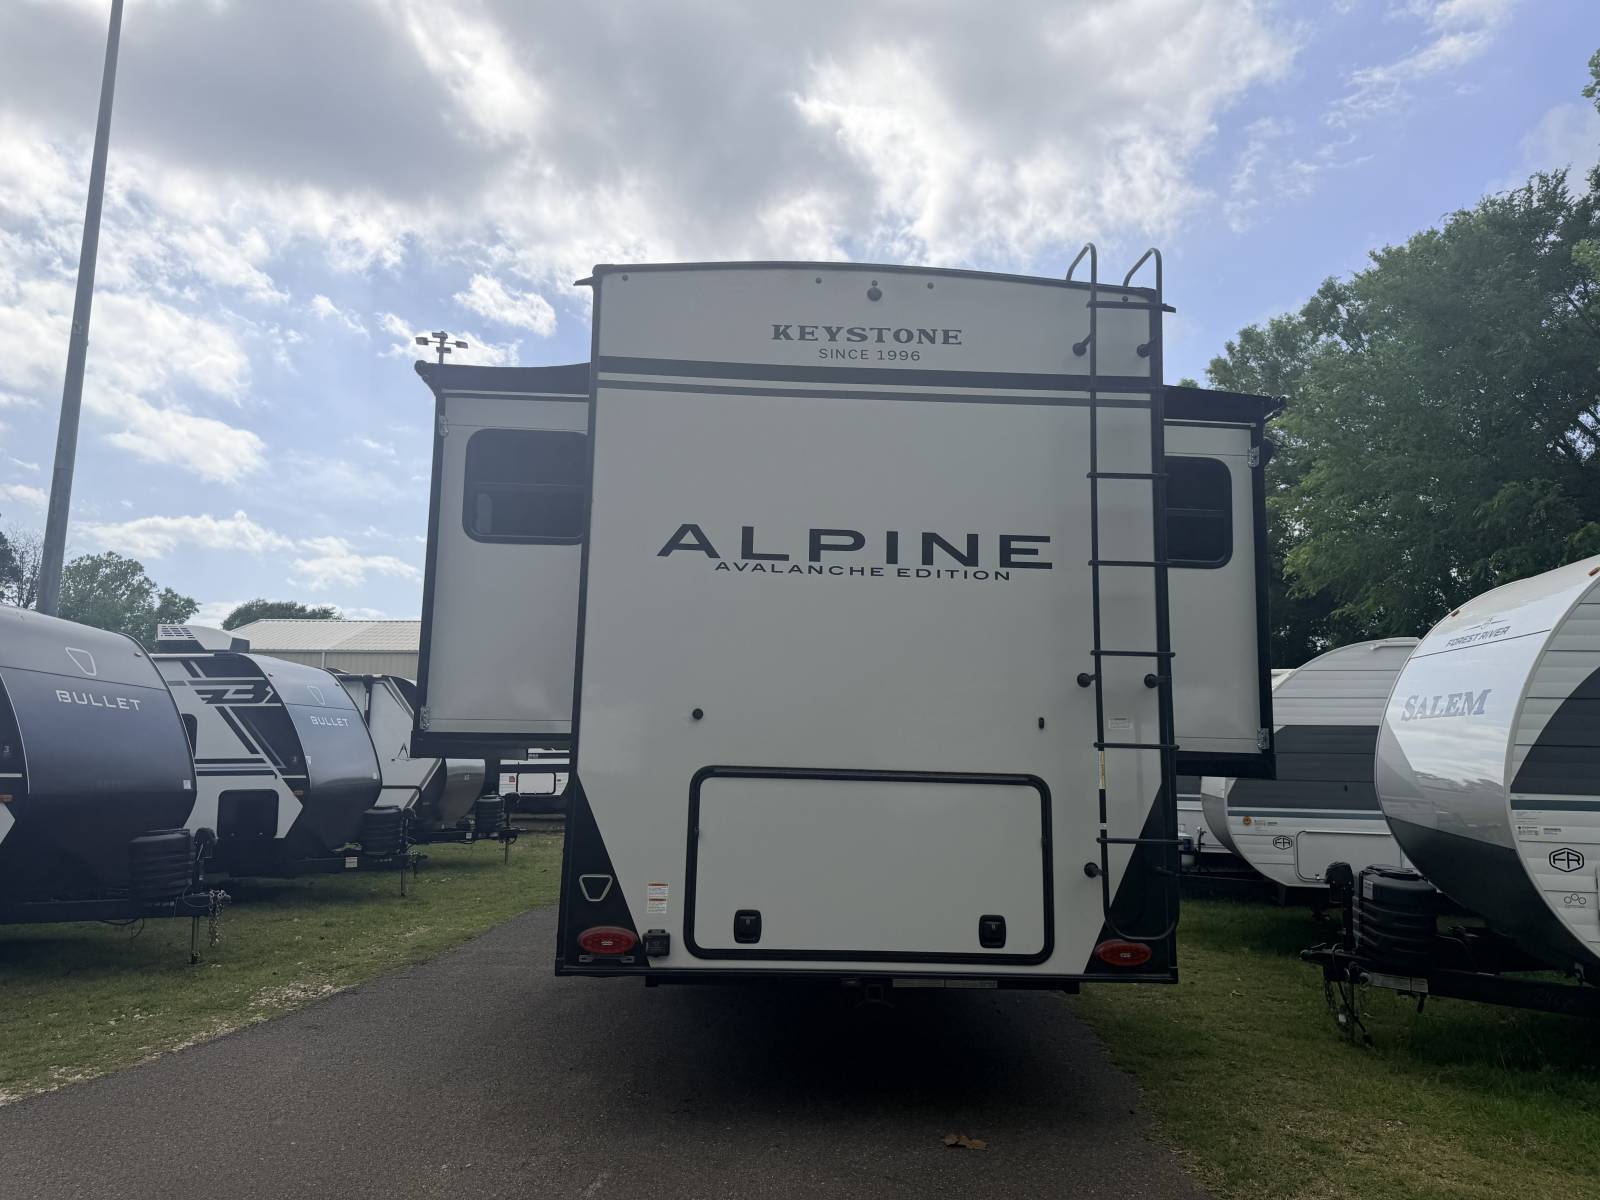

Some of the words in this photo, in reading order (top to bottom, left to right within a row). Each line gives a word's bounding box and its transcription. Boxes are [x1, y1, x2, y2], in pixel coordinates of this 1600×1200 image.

[771, 324, 962, 345] KEYSTONE
[818, 348, 869, 360] SINCE
[877, 350, 921, 361] 1996
[656, 523, 1053, 570] ALPINE
[715, 561, 884, 577] AVALANCHE
[897, 568, 1010, 581] EDITION
[55, 689, 141, 711] BULLET
[1401, 688, 1492, 721] SALEM
[310, 715, 349, 728] BULLET
[1552, 850, 1582, 870] FR
